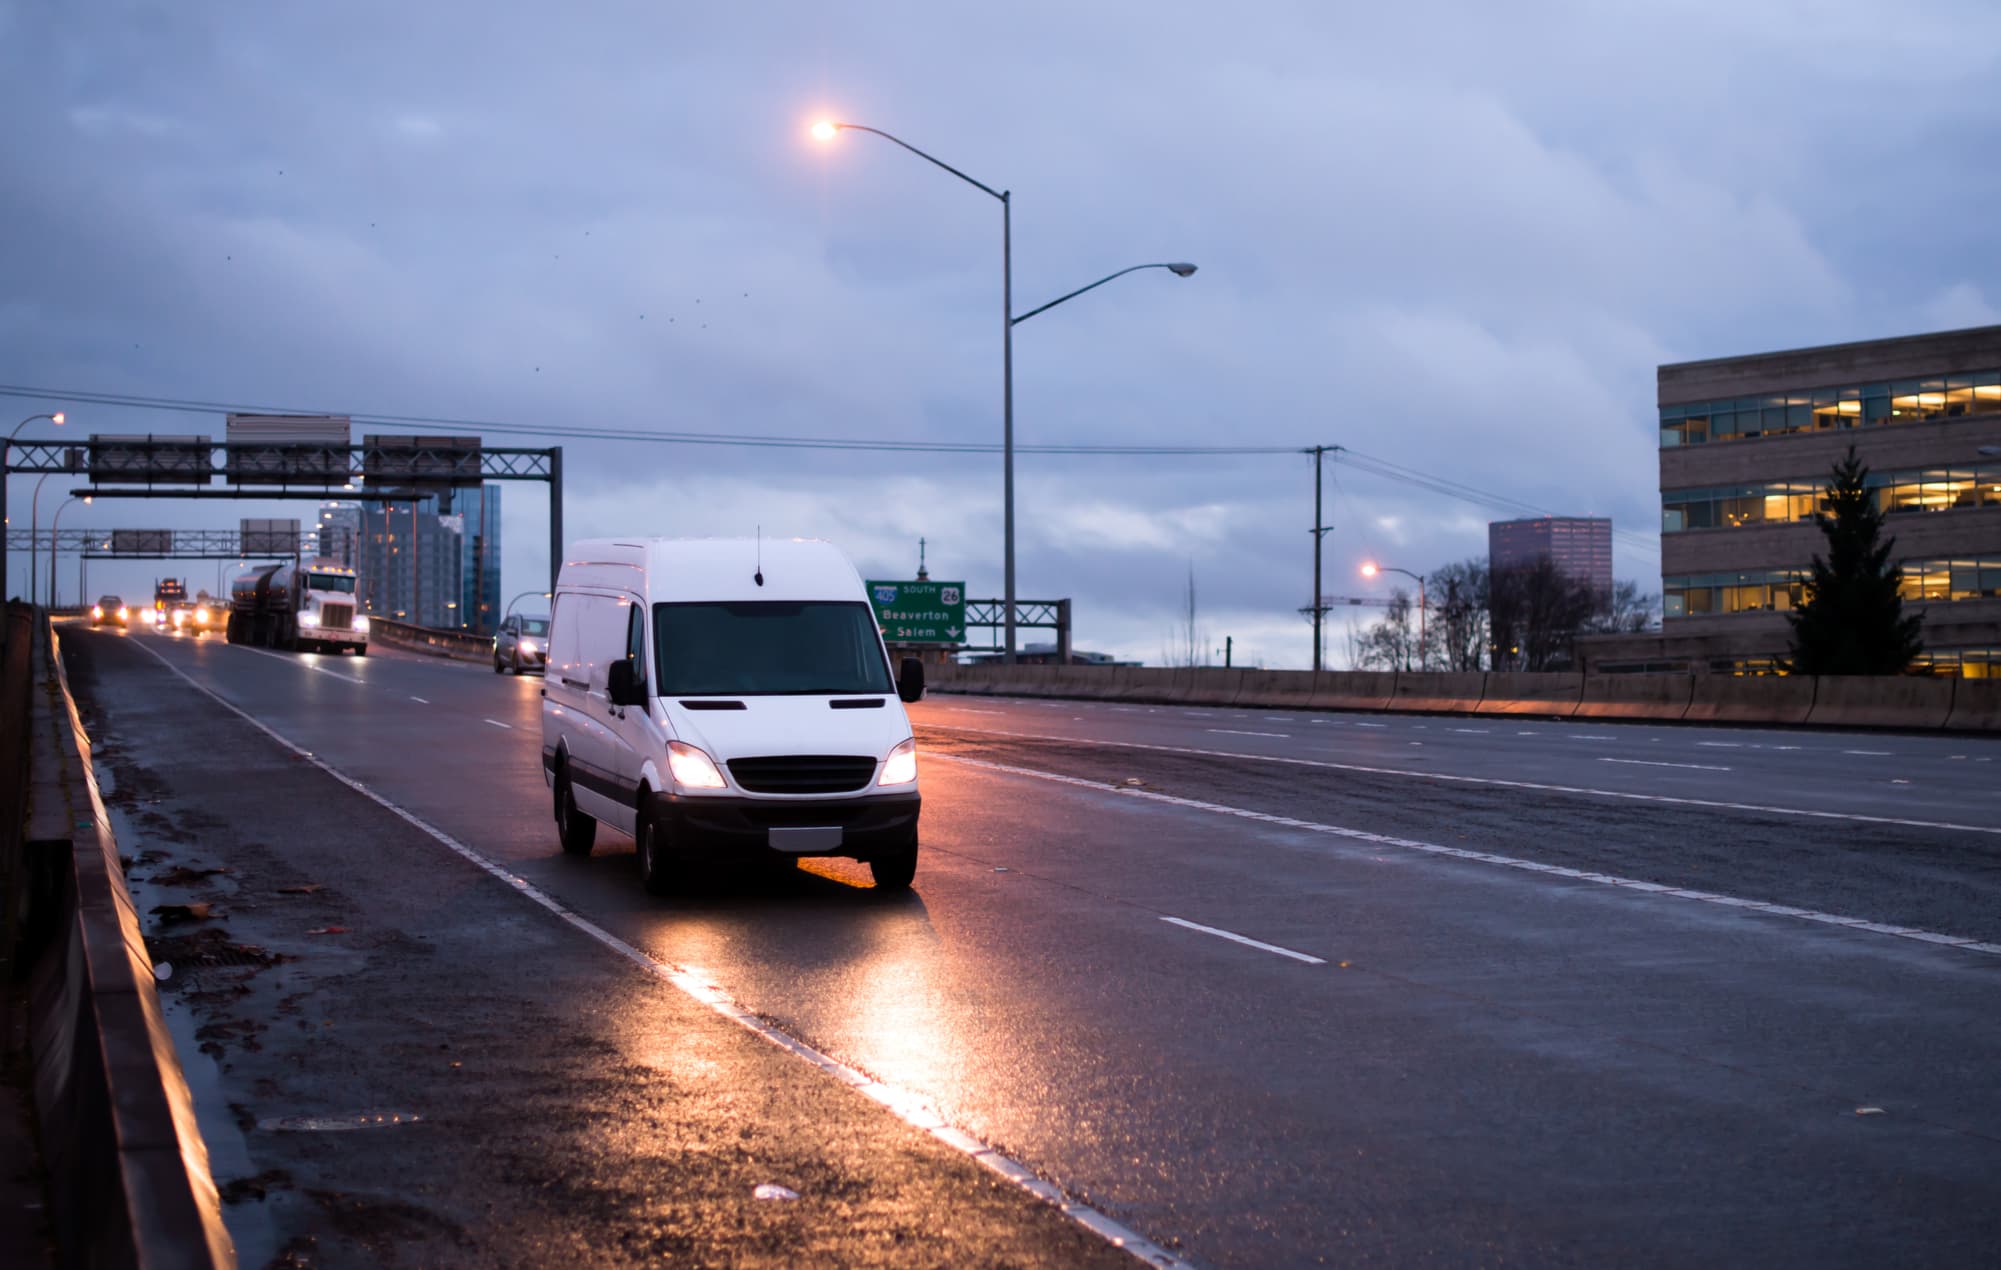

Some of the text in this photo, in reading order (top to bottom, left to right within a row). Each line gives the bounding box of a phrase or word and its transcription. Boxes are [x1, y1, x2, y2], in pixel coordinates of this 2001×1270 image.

[875, 589, 895, 602] 405
[903, 586, 936, 594] SOUTH
[943, 590, 959, 602] 26
[883, 609, 950, 620] Beaverton
[897, 626, 936, 637] Salem
